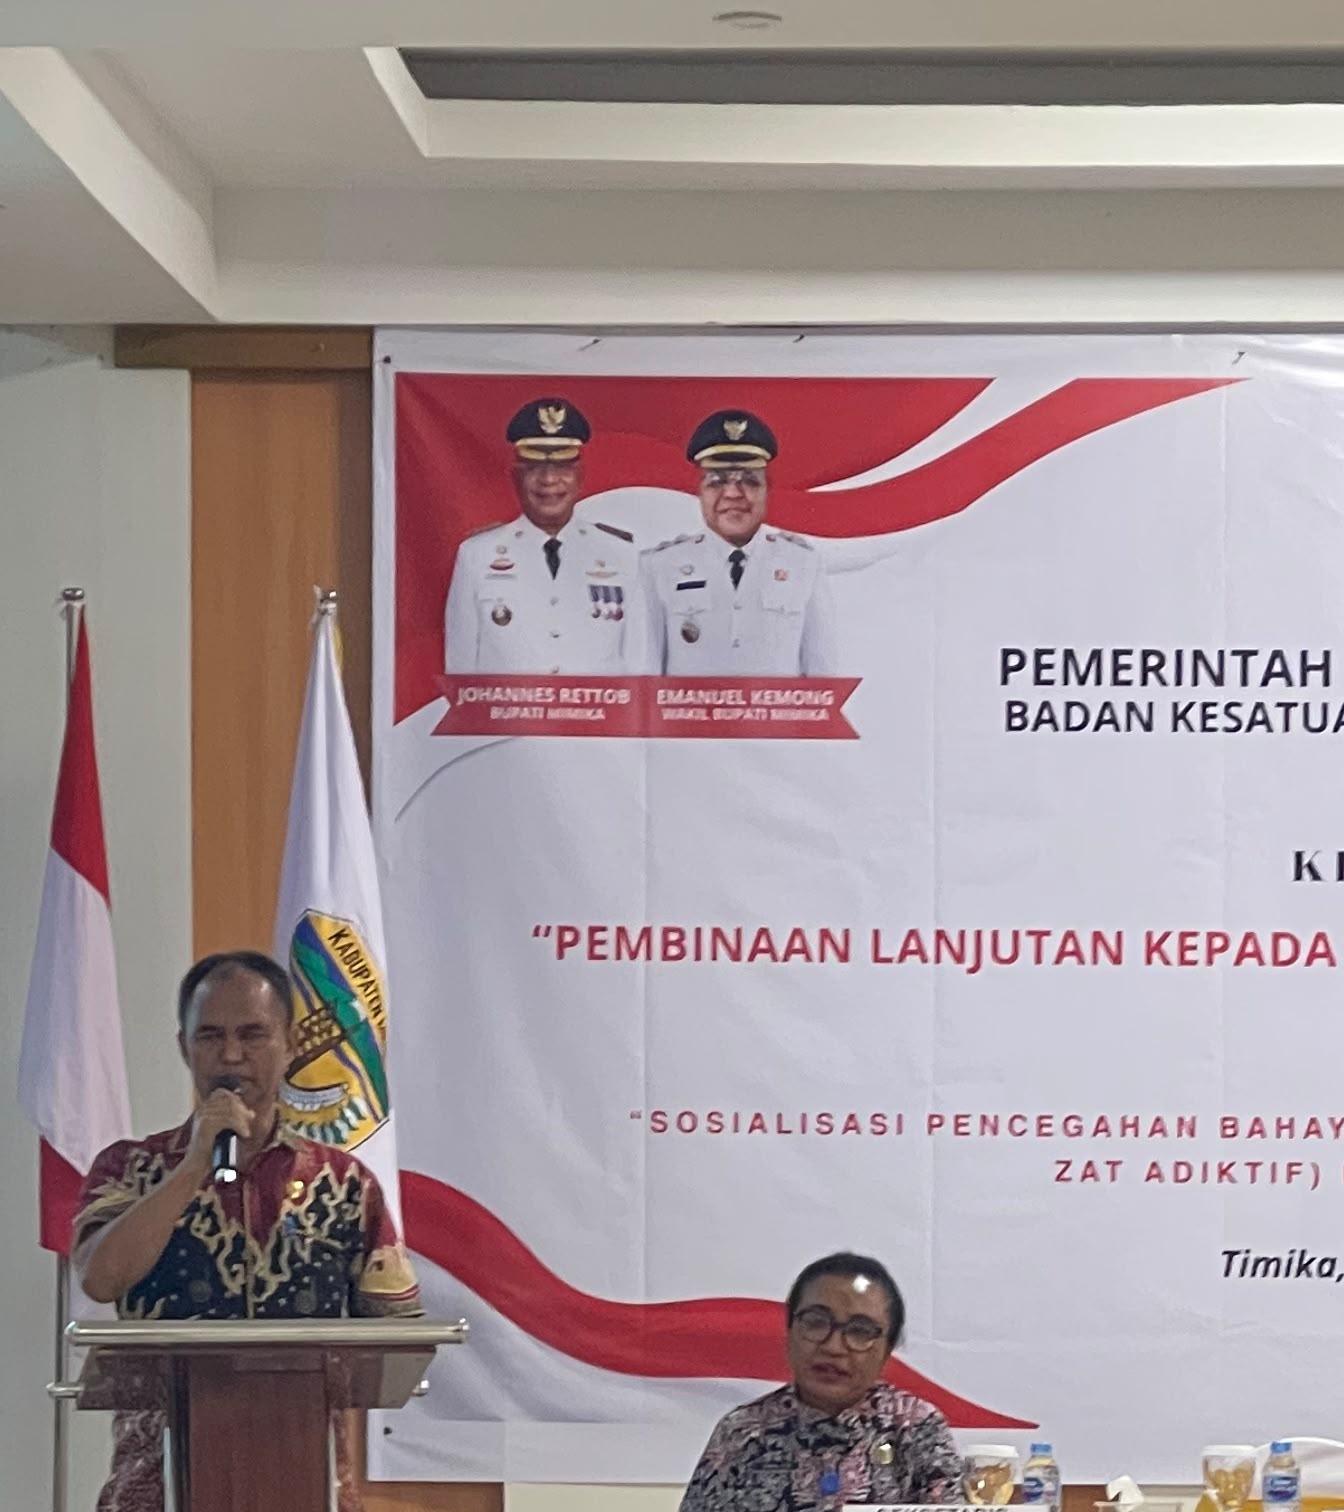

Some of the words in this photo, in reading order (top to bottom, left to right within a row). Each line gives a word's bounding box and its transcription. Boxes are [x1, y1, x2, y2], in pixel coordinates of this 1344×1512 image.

[1000, 647, 1331, 688] PEMERINTAH
[456, 687, 555, 705] JOHANNES
[656, 689, 747, 706] EMANUEL
[490, 707, 544, 720] BUPATI
[1005, 700, 1154, 733] BADAN
[871, 928, 1123, 975] LANJUTAN
[1144, 930, 1337, 968] KEPADA
[926, 1113, 1197, 1139] PENCEGAHAN
[1054, 1159, 1123, 1183] ZAT
[1144, 1160, 1320, 1191] ADIKTIF)
[1221, 1248, 1344, 1283] Timika,
